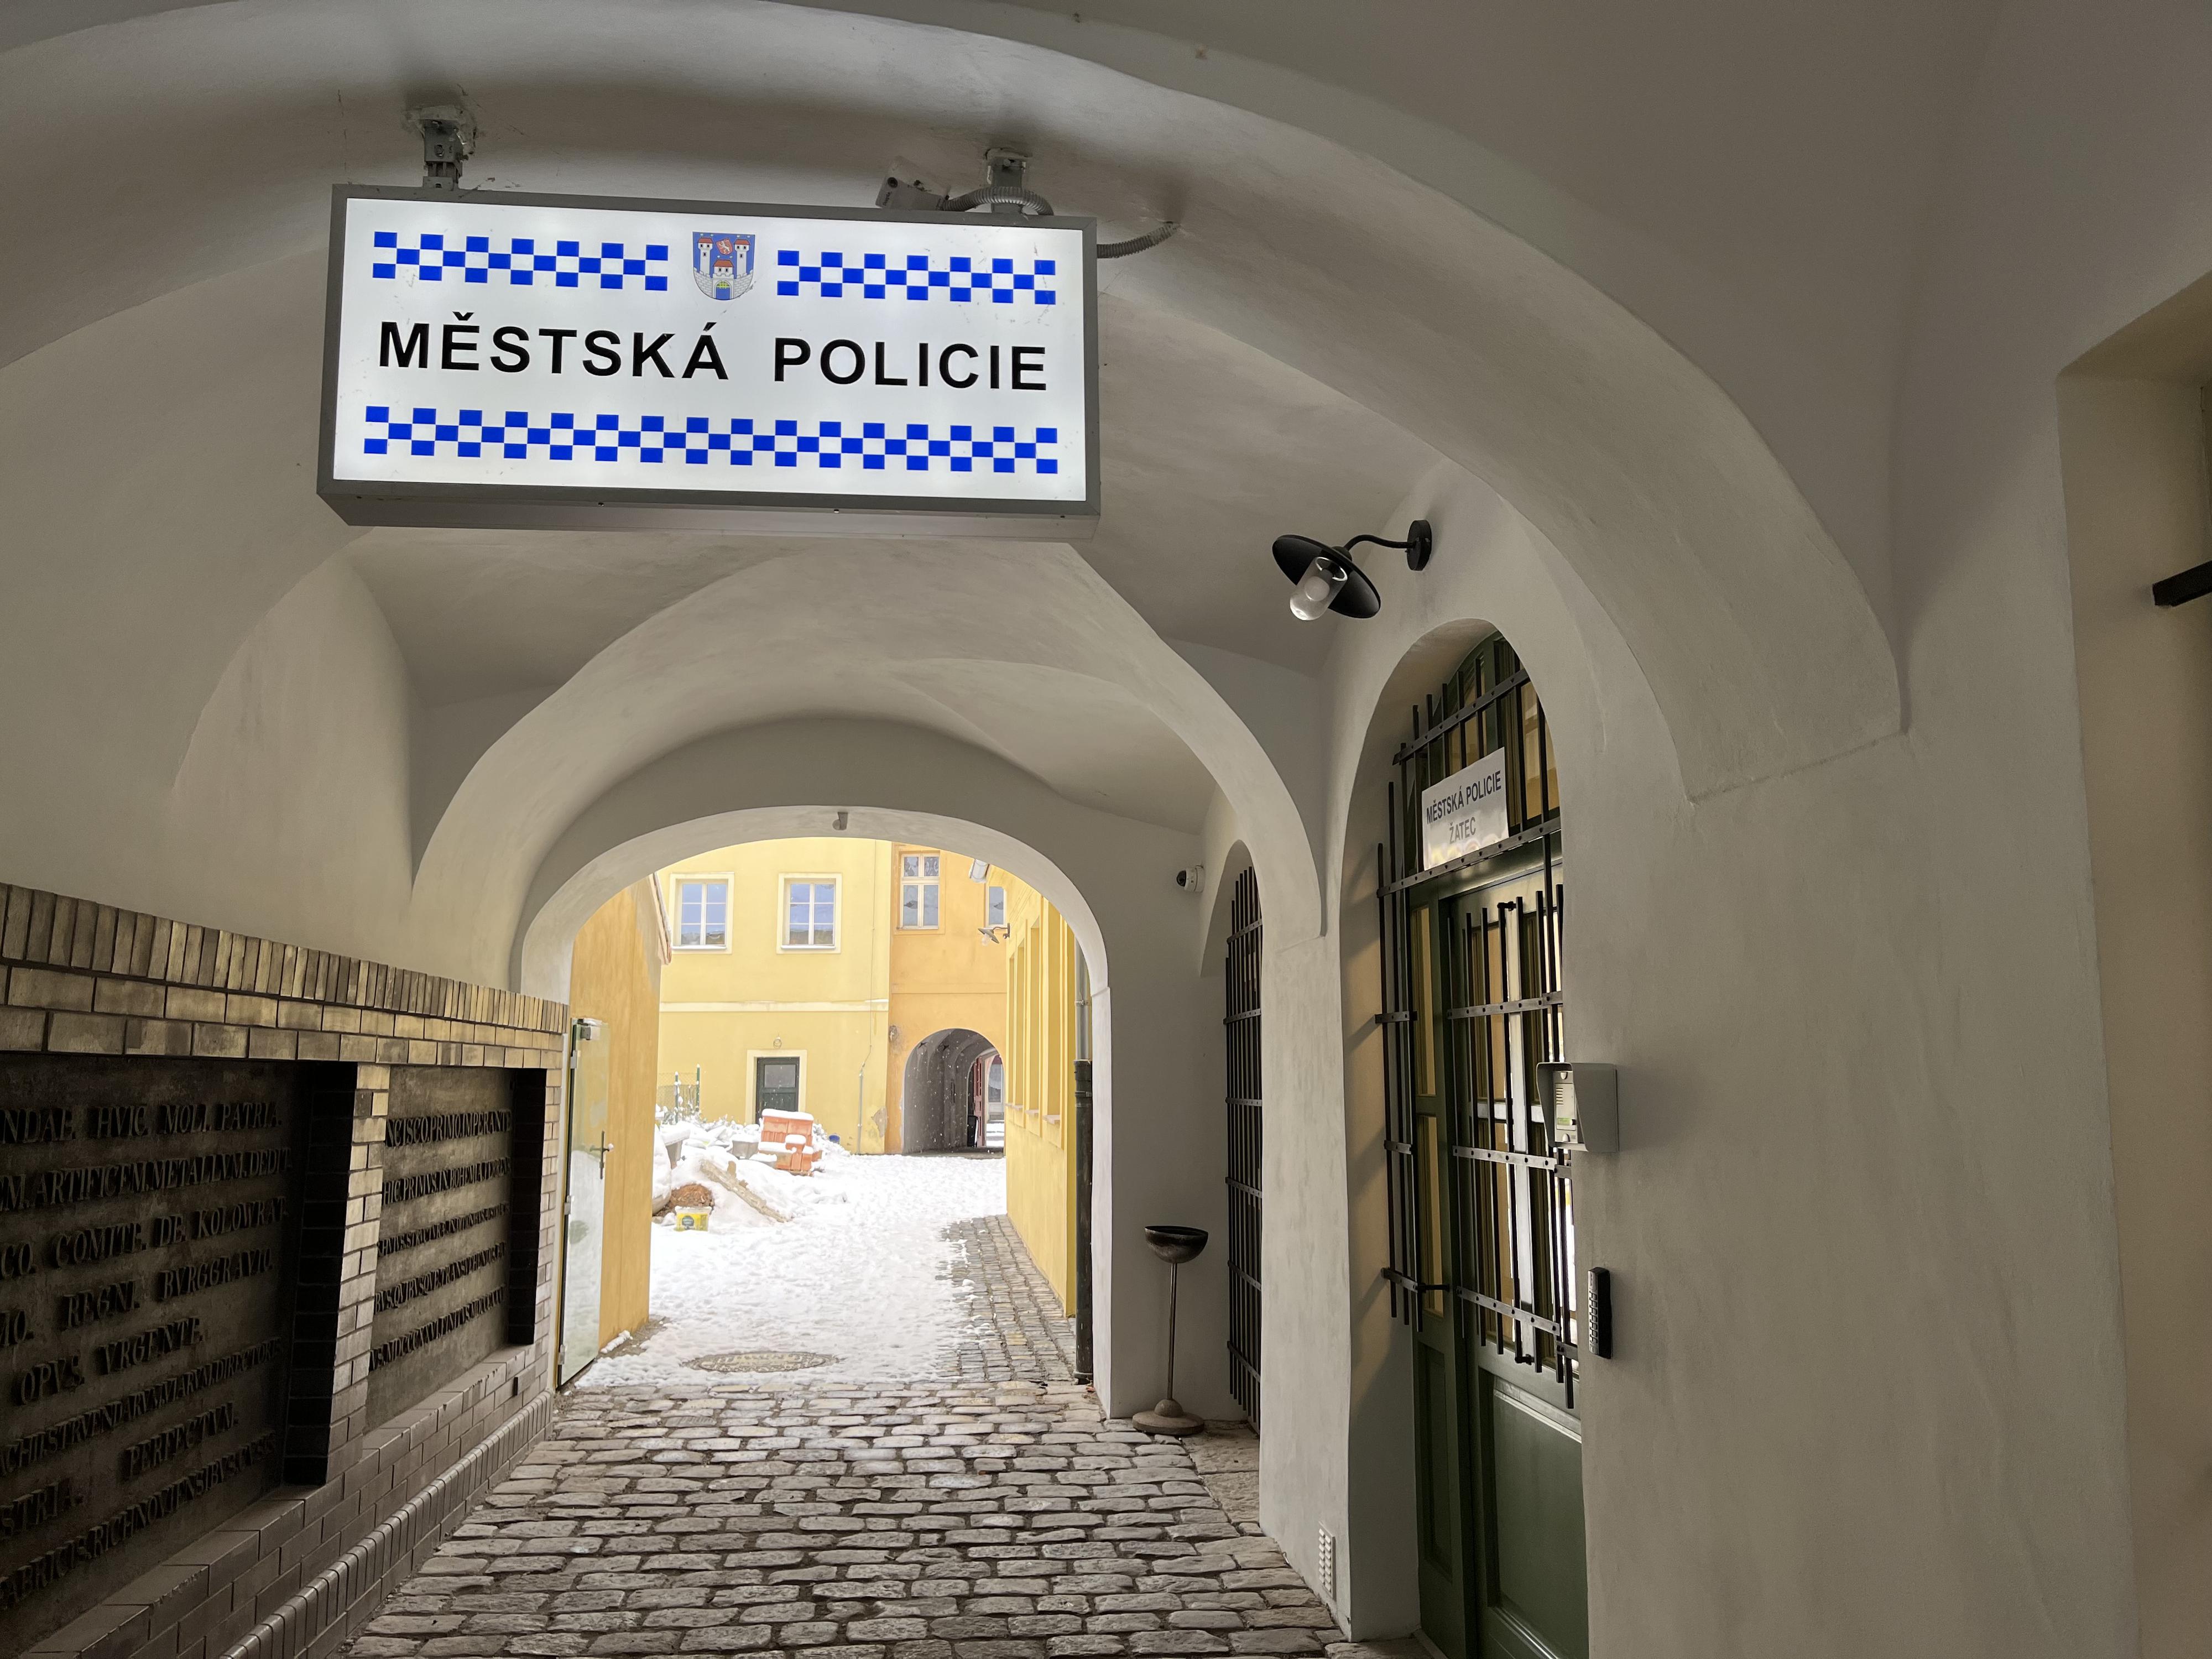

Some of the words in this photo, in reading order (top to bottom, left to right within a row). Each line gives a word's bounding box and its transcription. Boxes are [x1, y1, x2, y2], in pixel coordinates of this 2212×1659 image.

[378, 312, 729, 380] MĚSTSKÁ
[774, 338, 1047, 391] POLICIE
[1426, 785, 1464, 825] MĚSTSKÁ
[1466, 770, 1502, 805] POLICIE
[1449, 816, 1477, 844] ŽATEC
